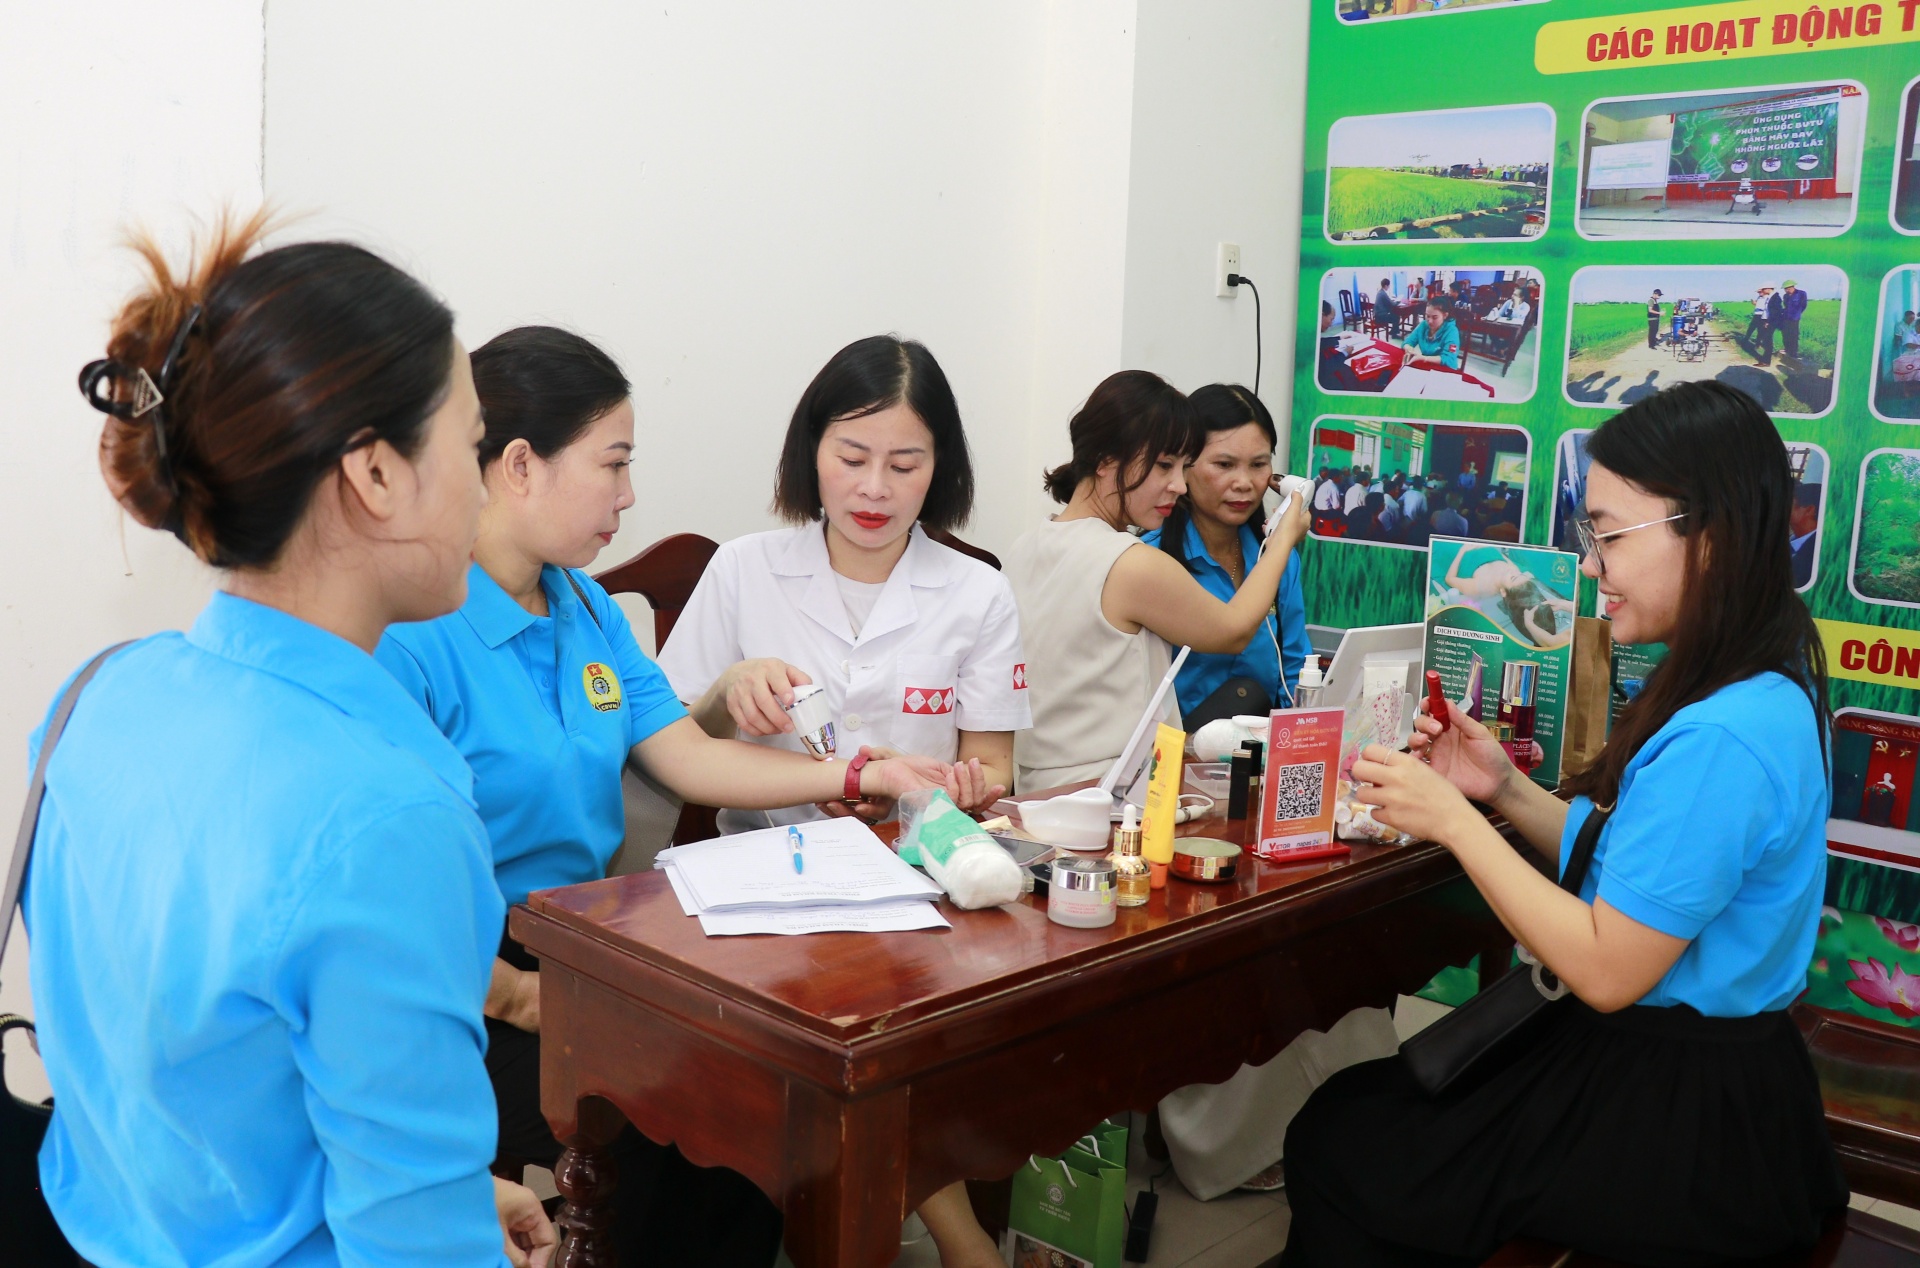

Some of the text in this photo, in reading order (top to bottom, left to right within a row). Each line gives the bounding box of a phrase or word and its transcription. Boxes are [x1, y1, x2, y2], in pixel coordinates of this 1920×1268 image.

[1586, 26, 1653, 62] CÁC
[1665, 17, 1760, 57] HOẠT
[1772, 4, 1881, 48] ĐỘNG
[1762, 121, 1793, 132] THUỐC
